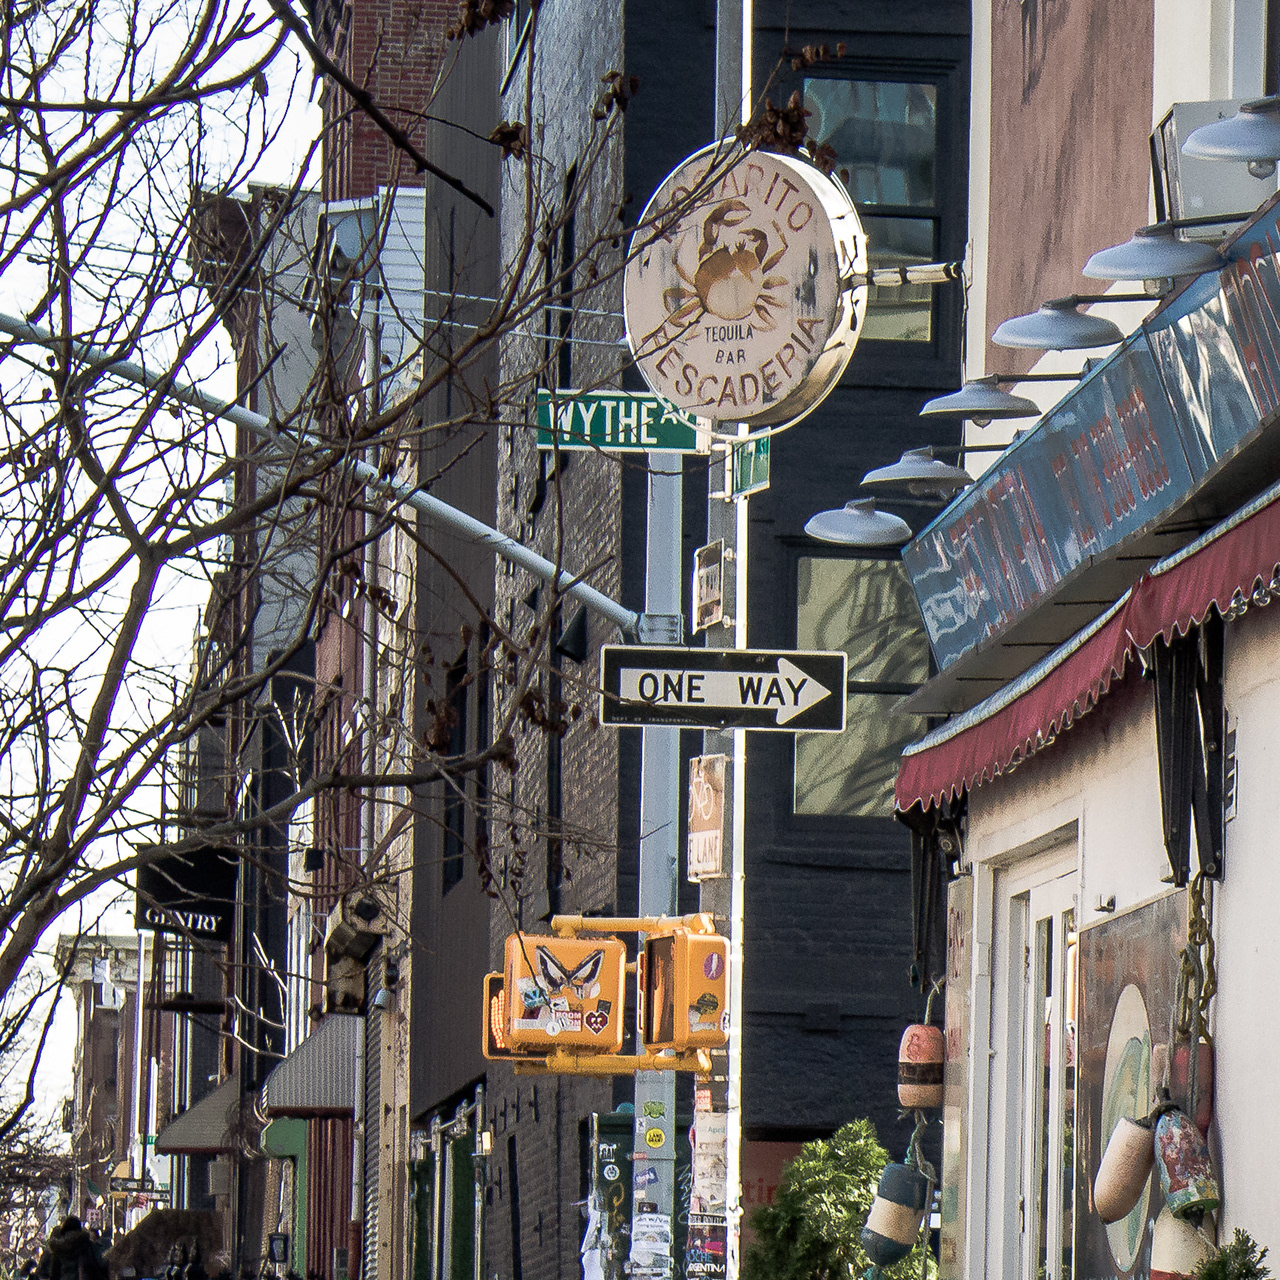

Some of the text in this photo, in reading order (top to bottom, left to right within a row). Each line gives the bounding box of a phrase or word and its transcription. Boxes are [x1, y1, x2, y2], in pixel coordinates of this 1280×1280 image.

[704, 322, 754, 343] TEQUILA
[715, 348, 747, 364] BAR
[549, 399, 658, 444] WYTHE
[638, 673, 808, 706] ONE WAY
